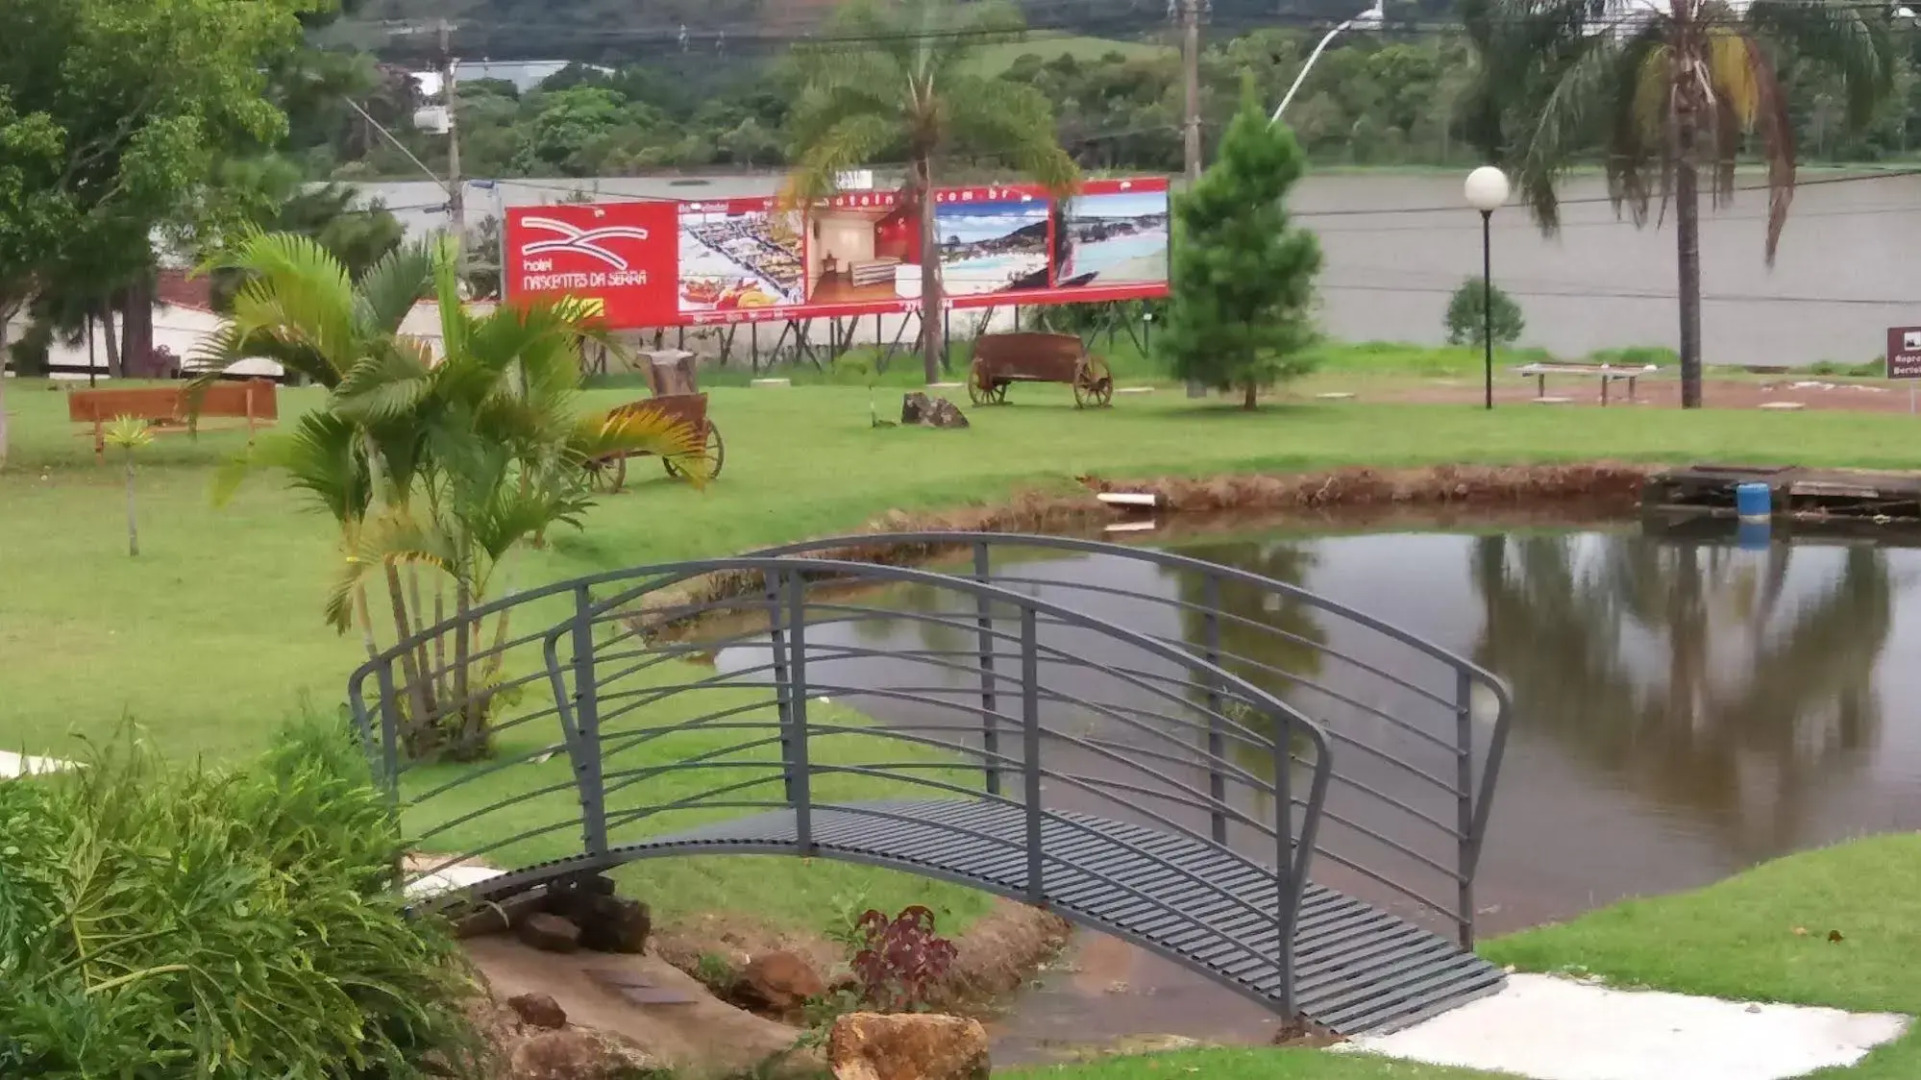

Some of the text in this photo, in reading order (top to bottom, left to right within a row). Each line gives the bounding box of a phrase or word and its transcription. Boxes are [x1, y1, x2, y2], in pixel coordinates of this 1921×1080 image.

[523, 258, 552, 271] hotel
[589, 271, 606, 287] DA
[608, 269, 647, 287] SERRA
